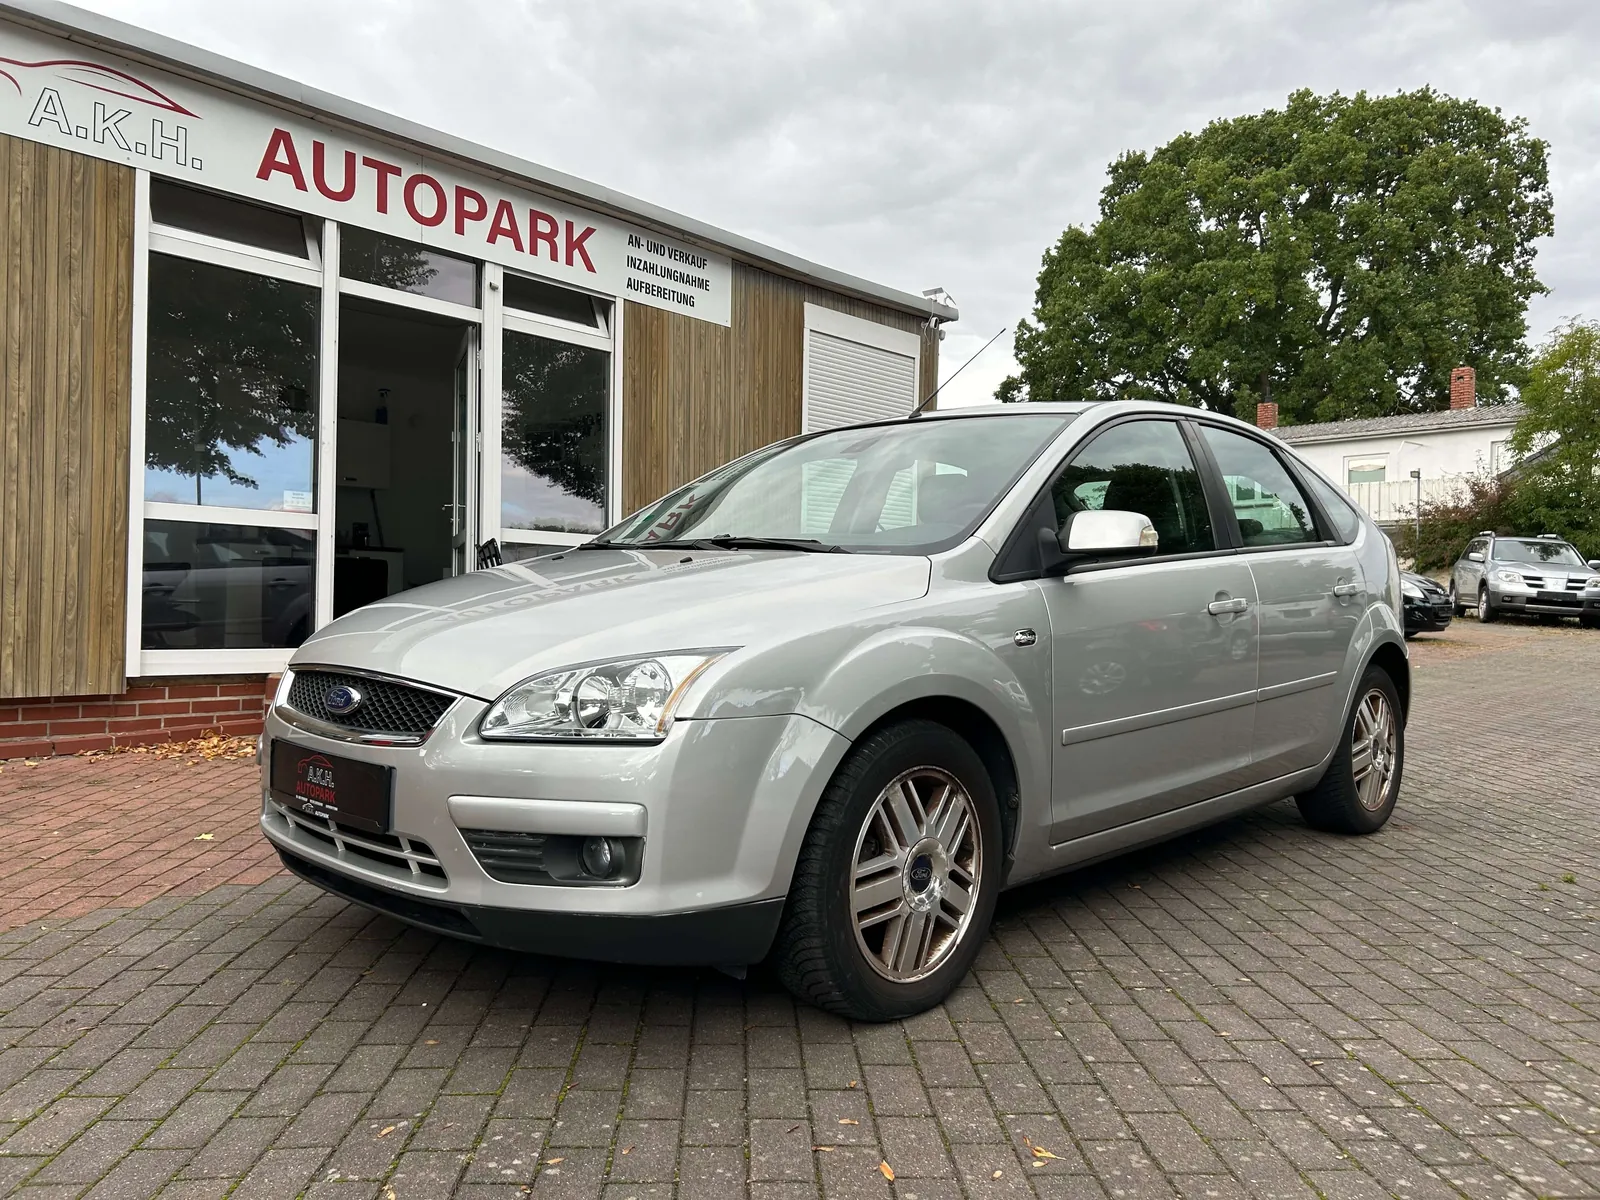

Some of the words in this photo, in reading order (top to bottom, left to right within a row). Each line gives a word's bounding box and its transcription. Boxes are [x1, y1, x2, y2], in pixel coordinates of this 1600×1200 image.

[27, 87, 203, 171] A.K.H.
[256, 128, 597, 274] AUTOPARK
[627, 234, 645, 249] AN-
[646, 239, 666, 257] UND
[667, 246, 708, 270] VERKAUF
[626, 254, 710, 292] INZAHLUNGNAHME
[626, 276, 695, 308] AUFBEREITUNG
[296, 780, 336, 804] AUTOPARK
[307, 765, 335, 788] A.K.H.
